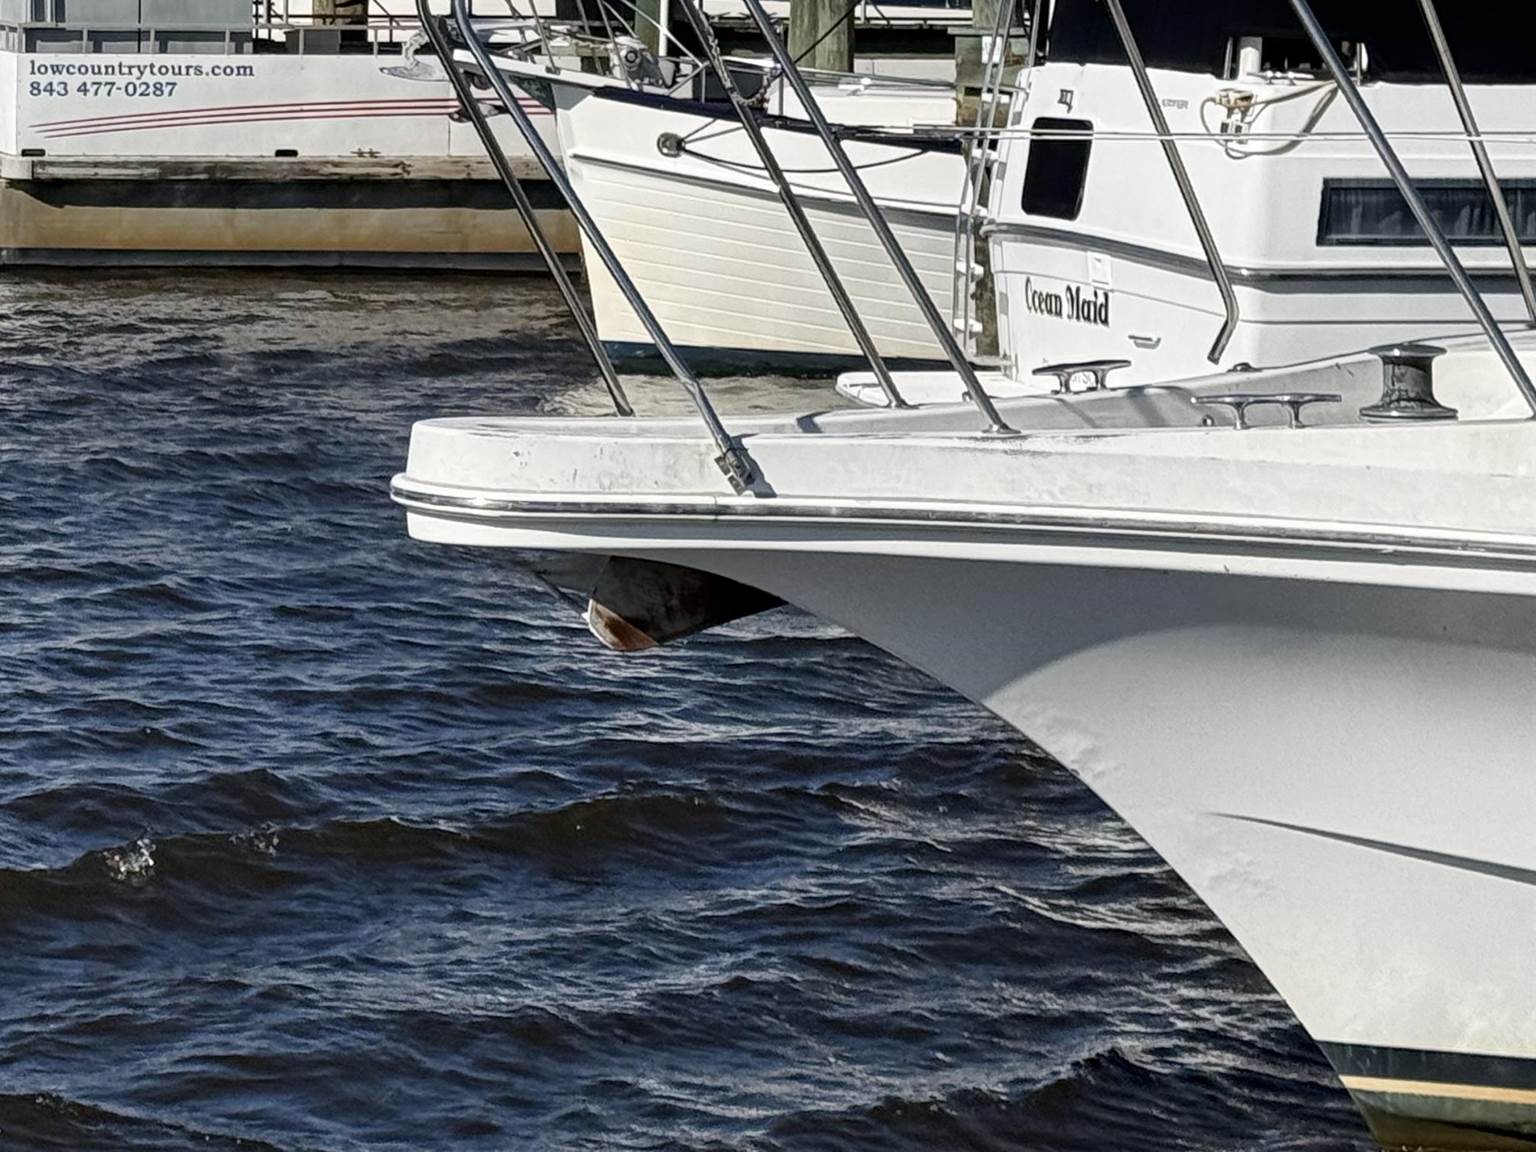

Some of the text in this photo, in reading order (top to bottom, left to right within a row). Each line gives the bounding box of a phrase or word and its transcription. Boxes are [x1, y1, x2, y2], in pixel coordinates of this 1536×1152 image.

[29, 60, 255, 80] lowcountrytours.com
[29, 81, 178, 97] 843 477-0287
[1025, 276, 1110, 327] Ocean Maid
